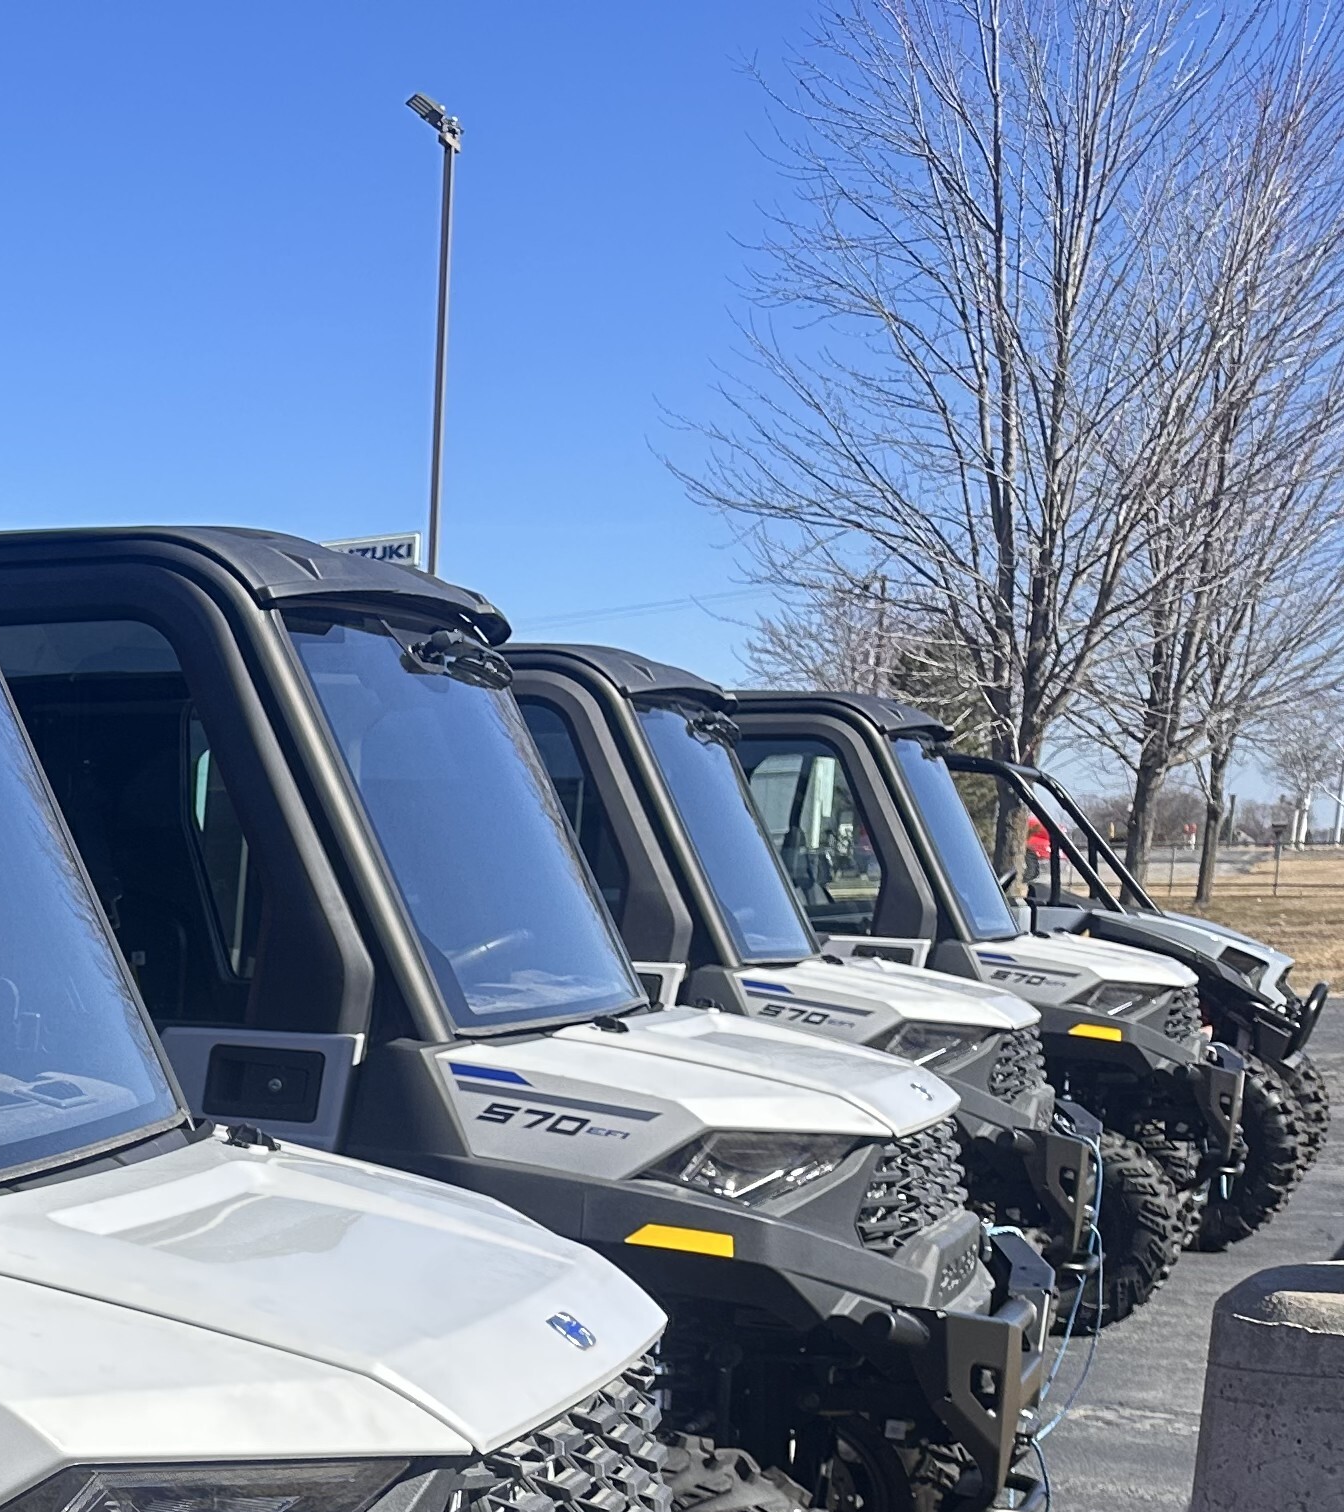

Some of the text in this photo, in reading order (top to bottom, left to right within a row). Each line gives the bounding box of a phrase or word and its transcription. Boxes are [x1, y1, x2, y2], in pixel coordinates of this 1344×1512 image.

[348, 543, 412, 560] ZUKI
[758, 1003, 831, 1025] 570
[476, 1102, 591, 1136] 570
